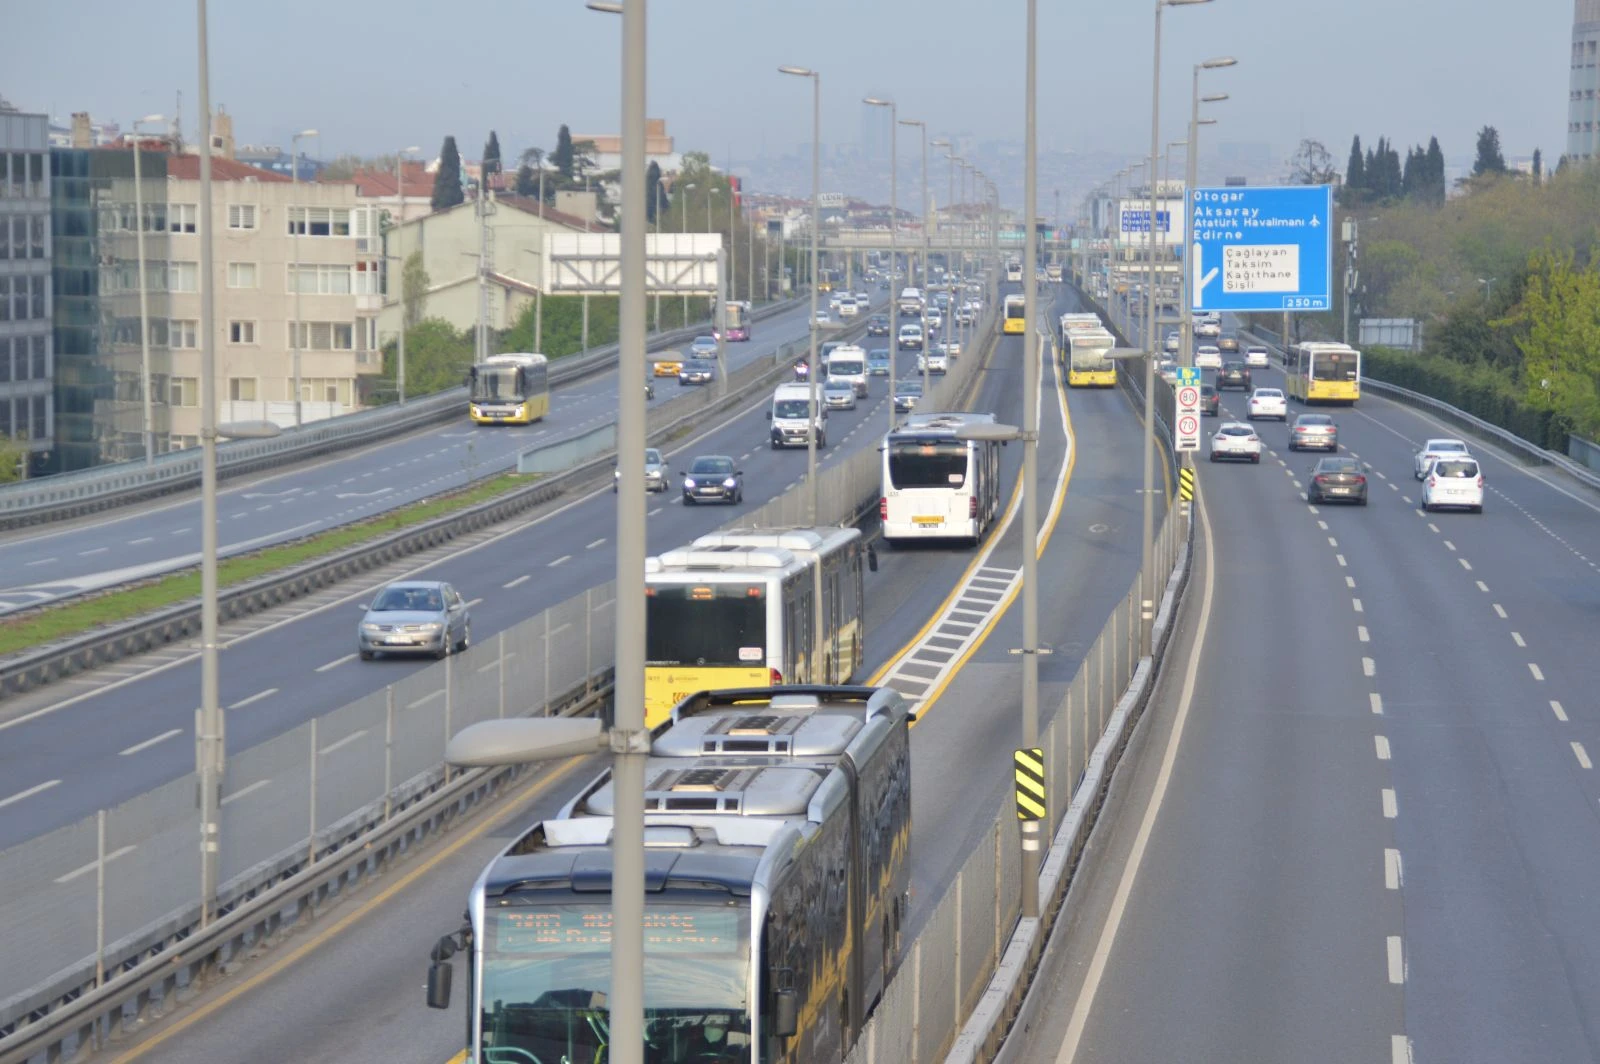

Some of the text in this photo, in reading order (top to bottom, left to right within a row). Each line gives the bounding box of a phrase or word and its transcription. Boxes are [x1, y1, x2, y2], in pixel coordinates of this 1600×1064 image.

[1194, 191, 1244, 203] Otogar
[1194, 206, 1259, 218] Aksaray
[1194, 217, 1305, 227] Atatürk Havalimanı
[1194, 230, 1242, 240] Edirne
[1226, 248, 1287, 258] Çağlayan
[1227, 260, 1272, 268] Taksim
[1226, 271, 1291, 280] Kağıthane
[1227, 281, 1254, 290] Şişli
[1287, 298, 1322, 307] 250 m
[1183, 392, 1194, 401] 80
[1183, 421, 1194, 430] 70
